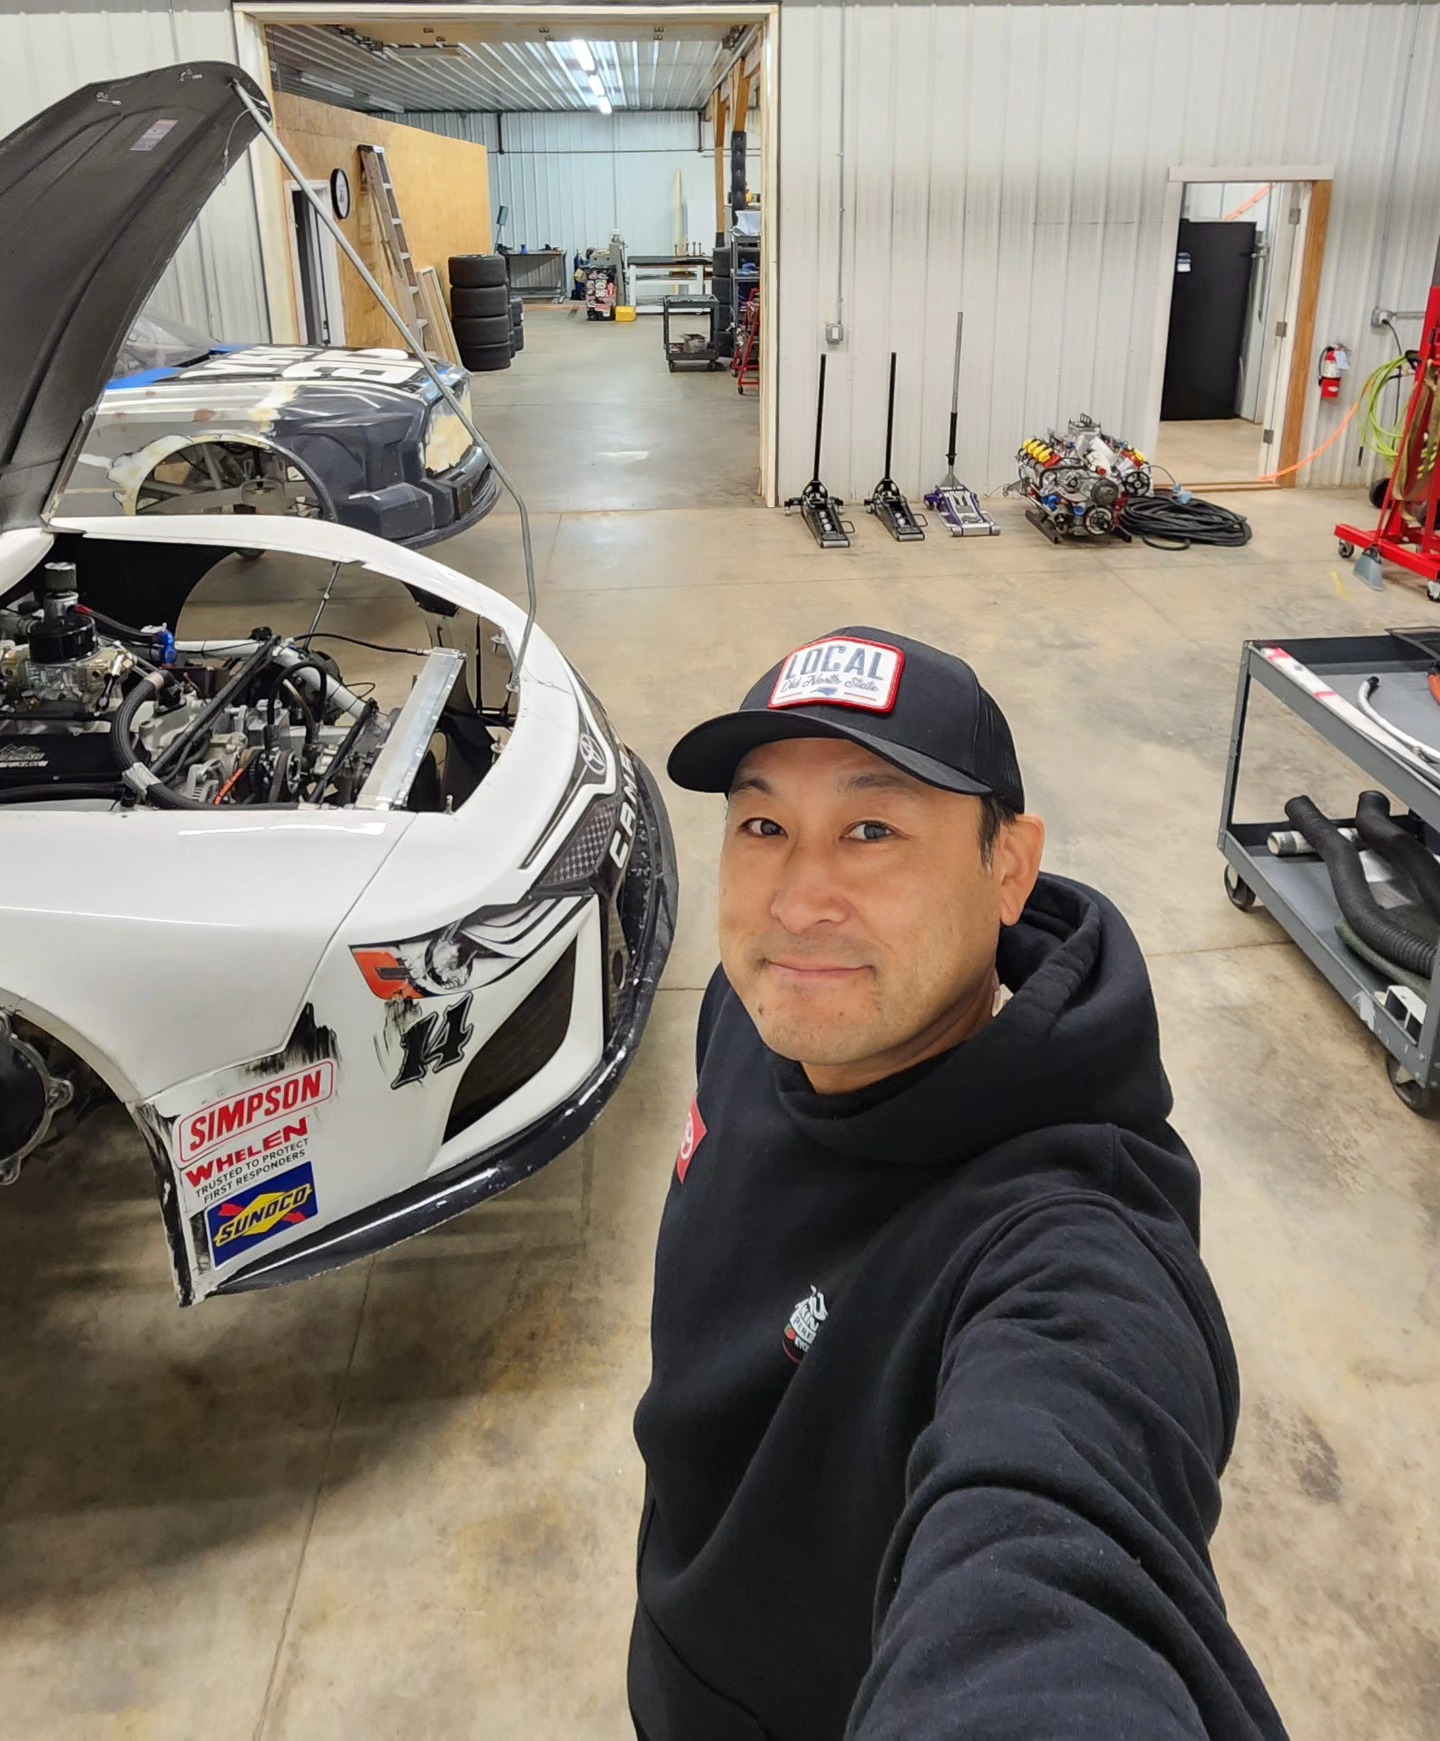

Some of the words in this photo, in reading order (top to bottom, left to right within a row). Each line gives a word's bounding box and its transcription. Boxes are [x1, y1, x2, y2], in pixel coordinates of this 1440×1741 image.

[785, 645, 883, 680] LOCAL
[391, 991, 474, 1089] 14
[190, 1070, 321, 1151] SIMPSON
[185, 1117, 308, 1188] WHELEN
[195, 1167, 242, 1198] TRUSTED
[245, 1159, 259, 1171] TO
[263, 1138, 309, 1163] PROTECT
[204, 1181, 232, 1204] FIRST
[236, 1150, 305, 1185] RESPONDERS
[218, 1186, 308, 1244] SUNOCO
